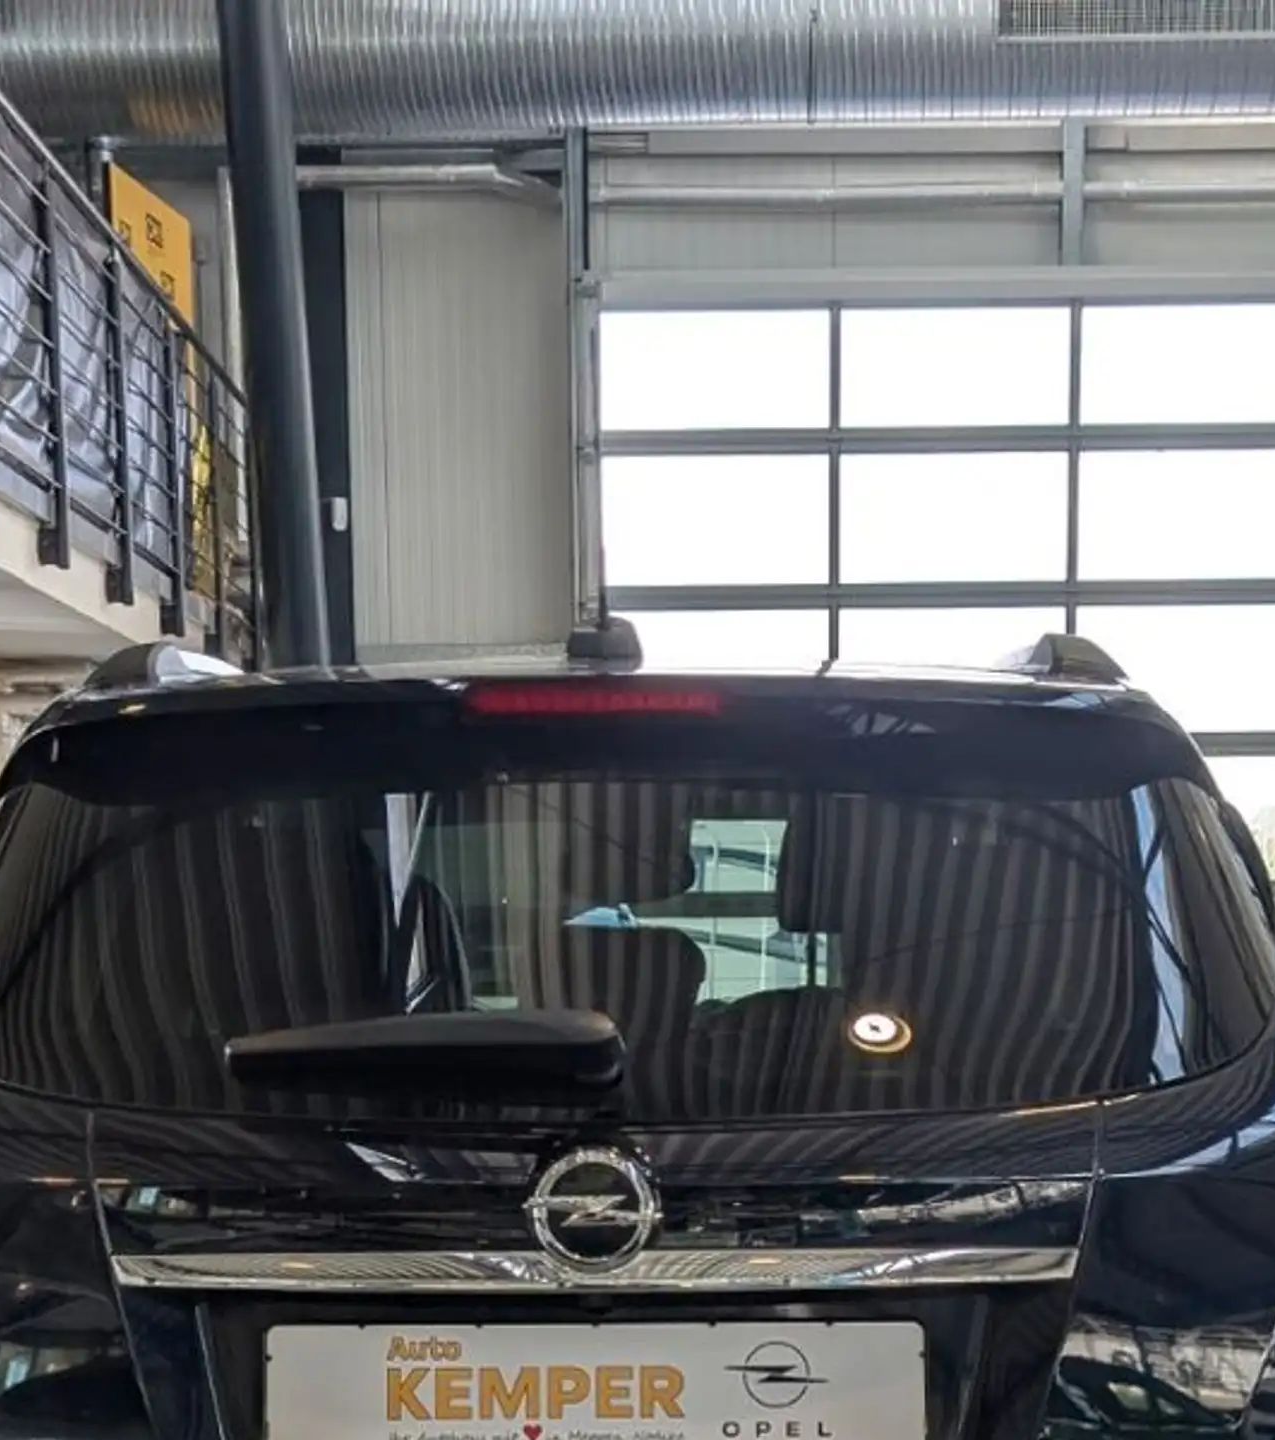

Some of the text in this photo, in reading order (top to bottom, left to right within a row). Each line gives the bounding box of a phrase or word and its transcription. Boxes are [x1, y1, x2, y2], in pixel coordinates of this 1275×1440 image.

[387, 1335, 462, 1361] Auto
[386, 1365, 685, 1421] KEMPER
[722, 1420, 834, 1439] OPEL
